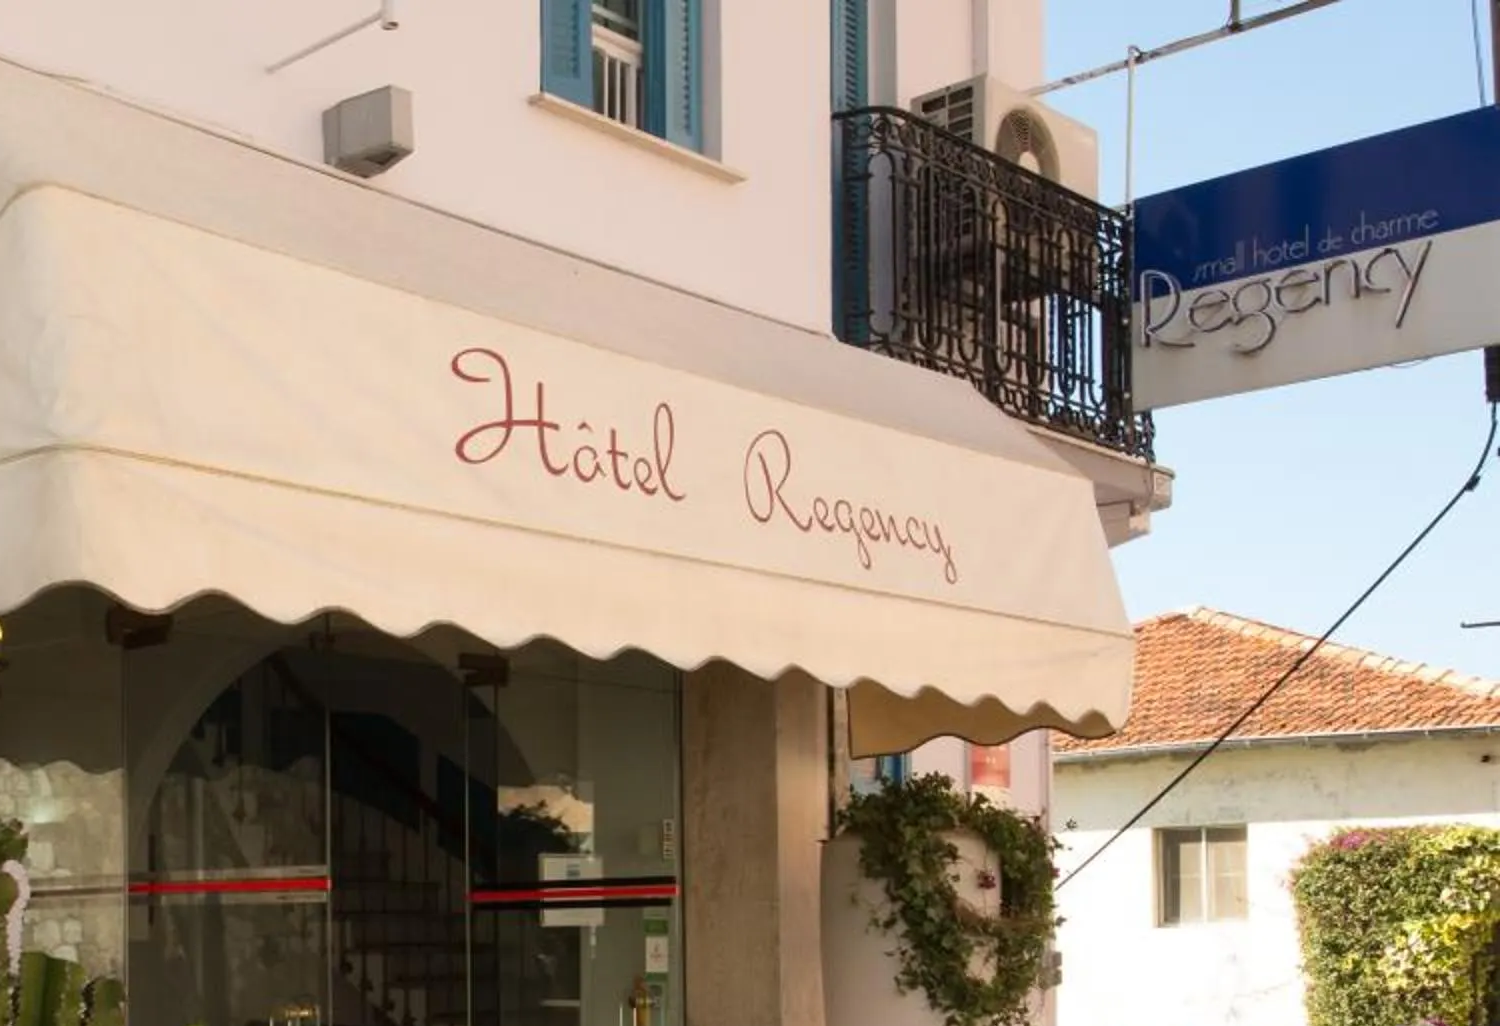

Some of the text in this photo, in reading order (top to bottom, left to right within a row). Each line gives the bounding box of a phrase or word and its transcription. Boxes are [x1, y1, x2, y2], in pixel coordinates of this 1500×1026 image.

[1252, 222, 1310, 268] hotel
[1317, 227, 1344, 251] de
[1350, 209, 1440, 246] charme
[1139, 239, 1433, 357] Regency
[451, 347, 958, 585] Hôtel Regency
